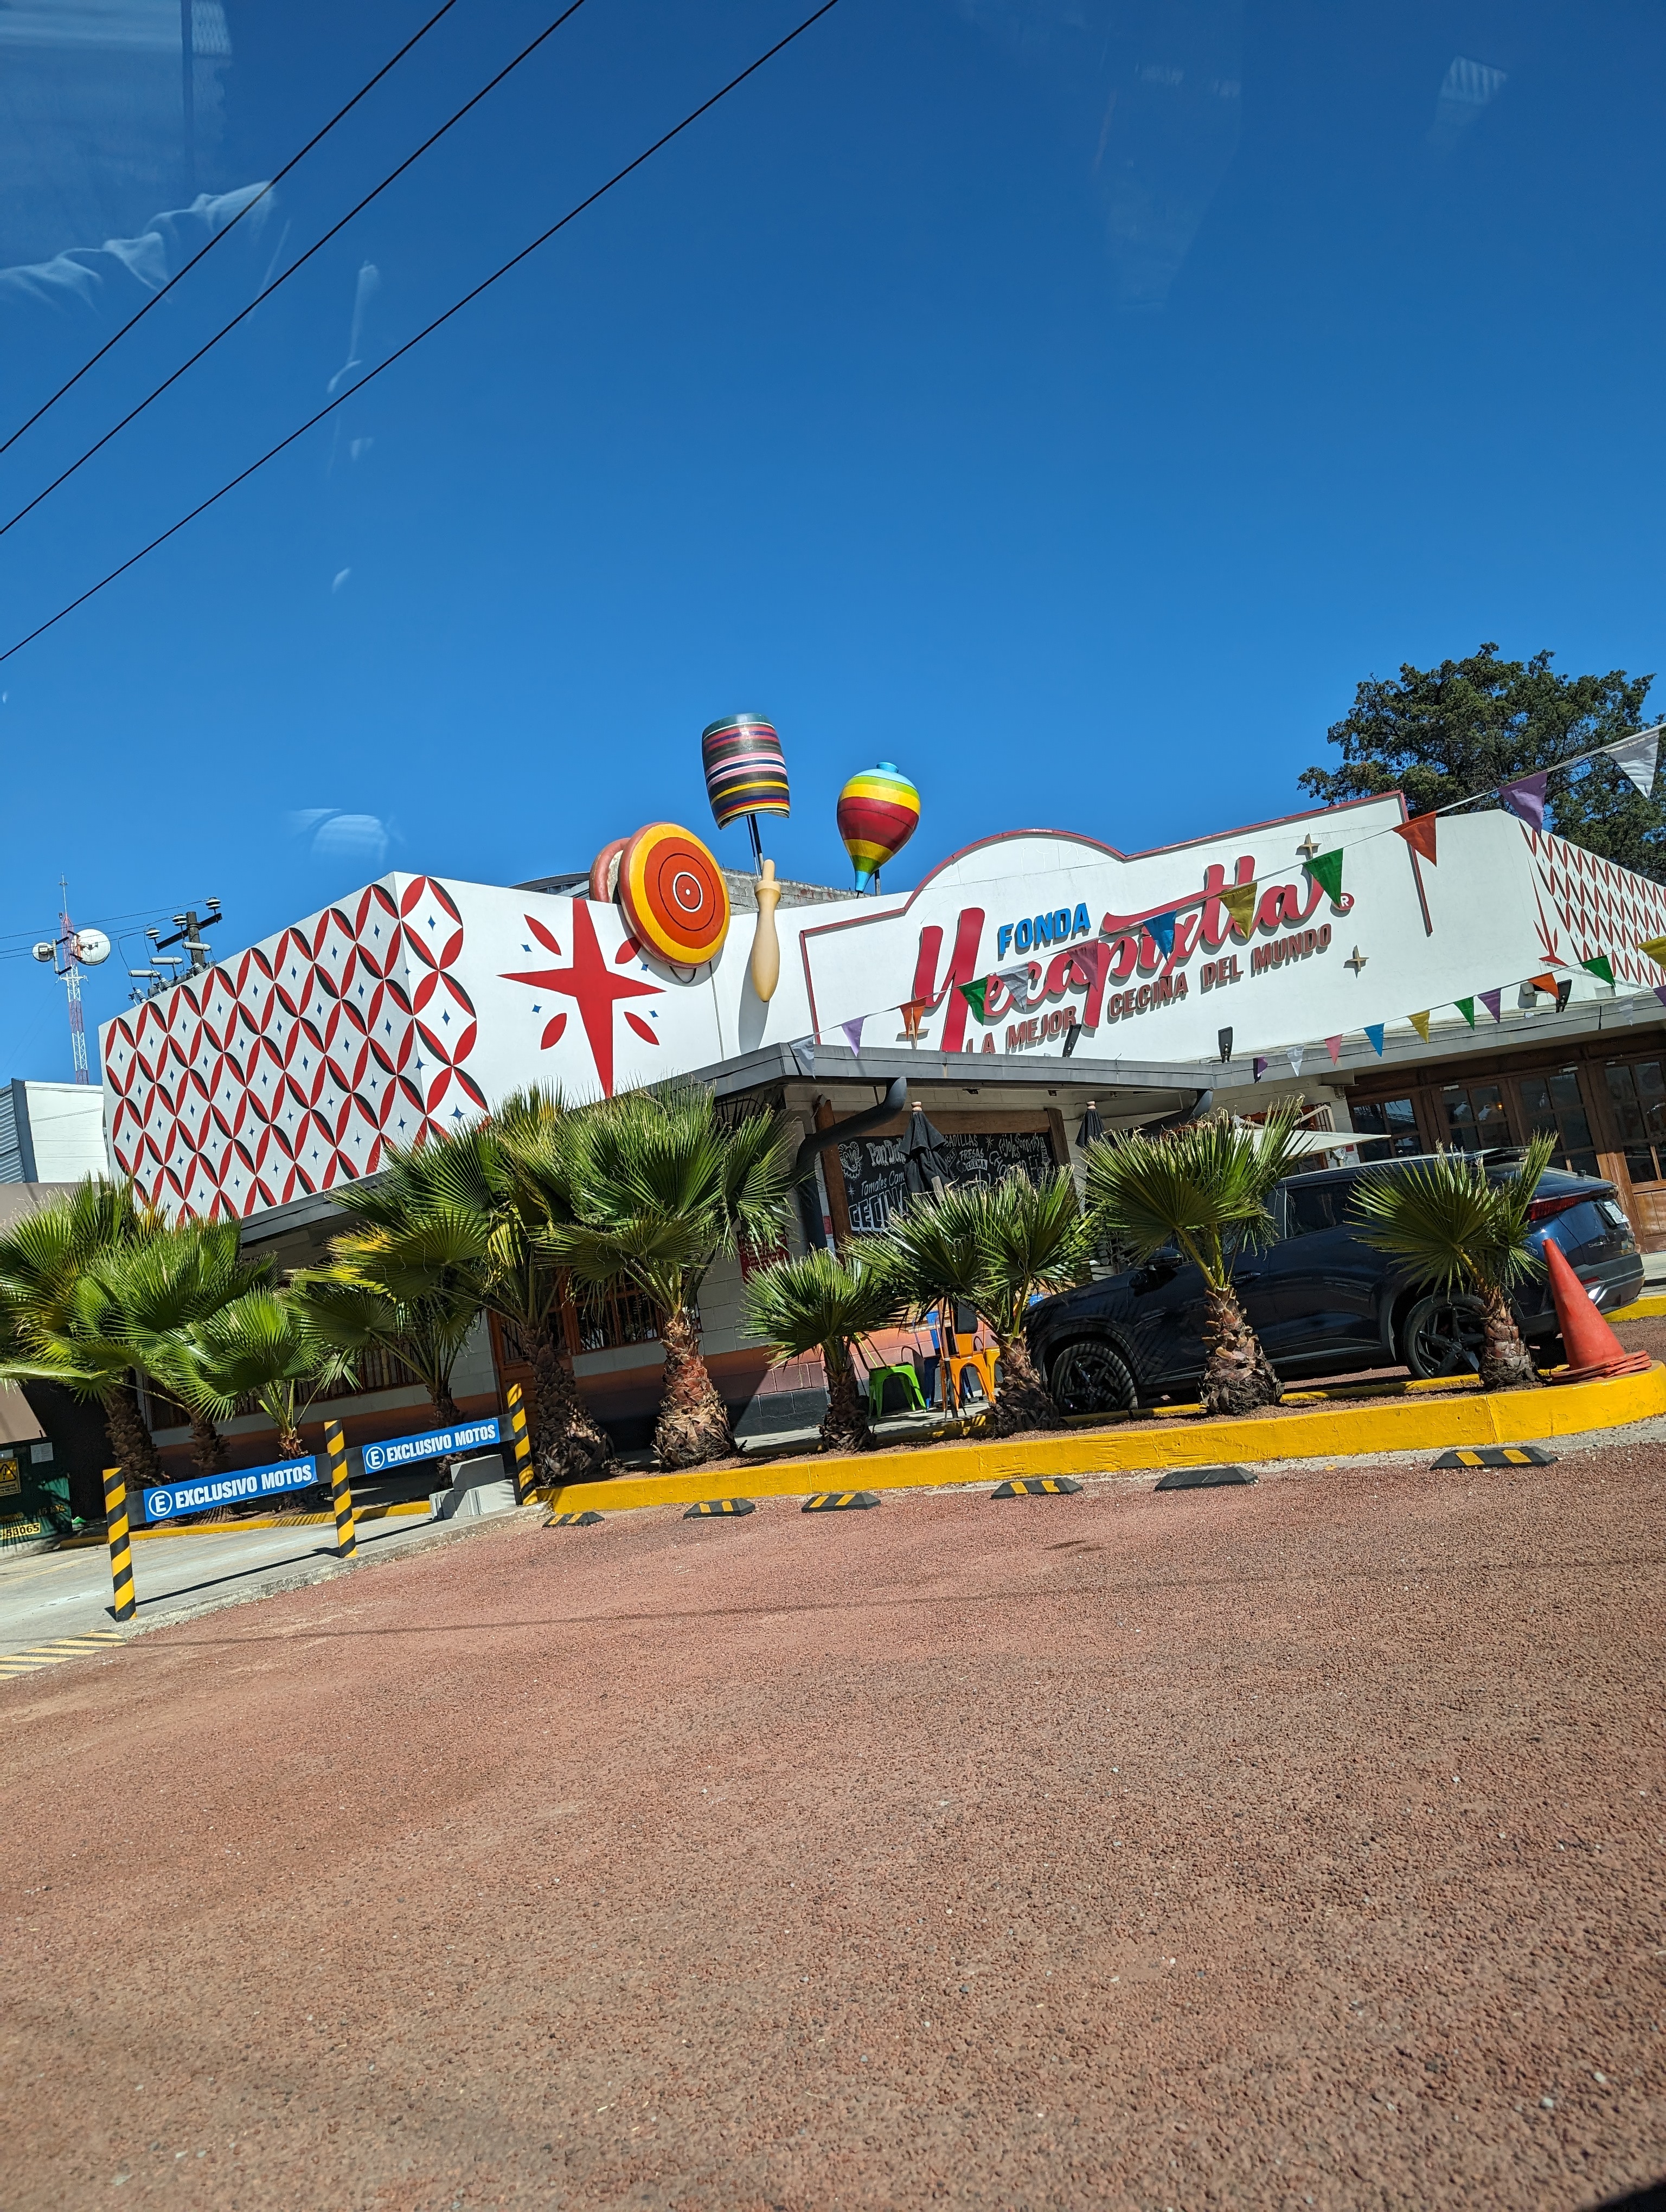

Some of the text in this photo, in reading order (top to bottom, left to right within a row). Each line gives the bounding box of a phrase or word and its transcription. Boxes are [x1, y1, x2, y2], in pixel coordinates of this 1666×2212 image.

[999, 902, 1091, 954] FONDA
[1007, 1005, 1077, 1049] MEJOR
[1108, 971, 1189, 1018] CECINA
[1202, 954, 1244, 988] DEL
[1253, 923, 1331, 971] MUNDO
[959, 1148, 984, 1161] FRESAS
[967, 1160, 986, 1170] CREMA
[861, 1173, 887, 1197] Tamales
[386, 1434, 452, 1463] EXCLUSIVO
[454, 1424, 496, 1446] MOTOS
[175, 1476, 258, 1509] EXCLUSIVO
[261, 1464, 312, 1490] MOTOS
